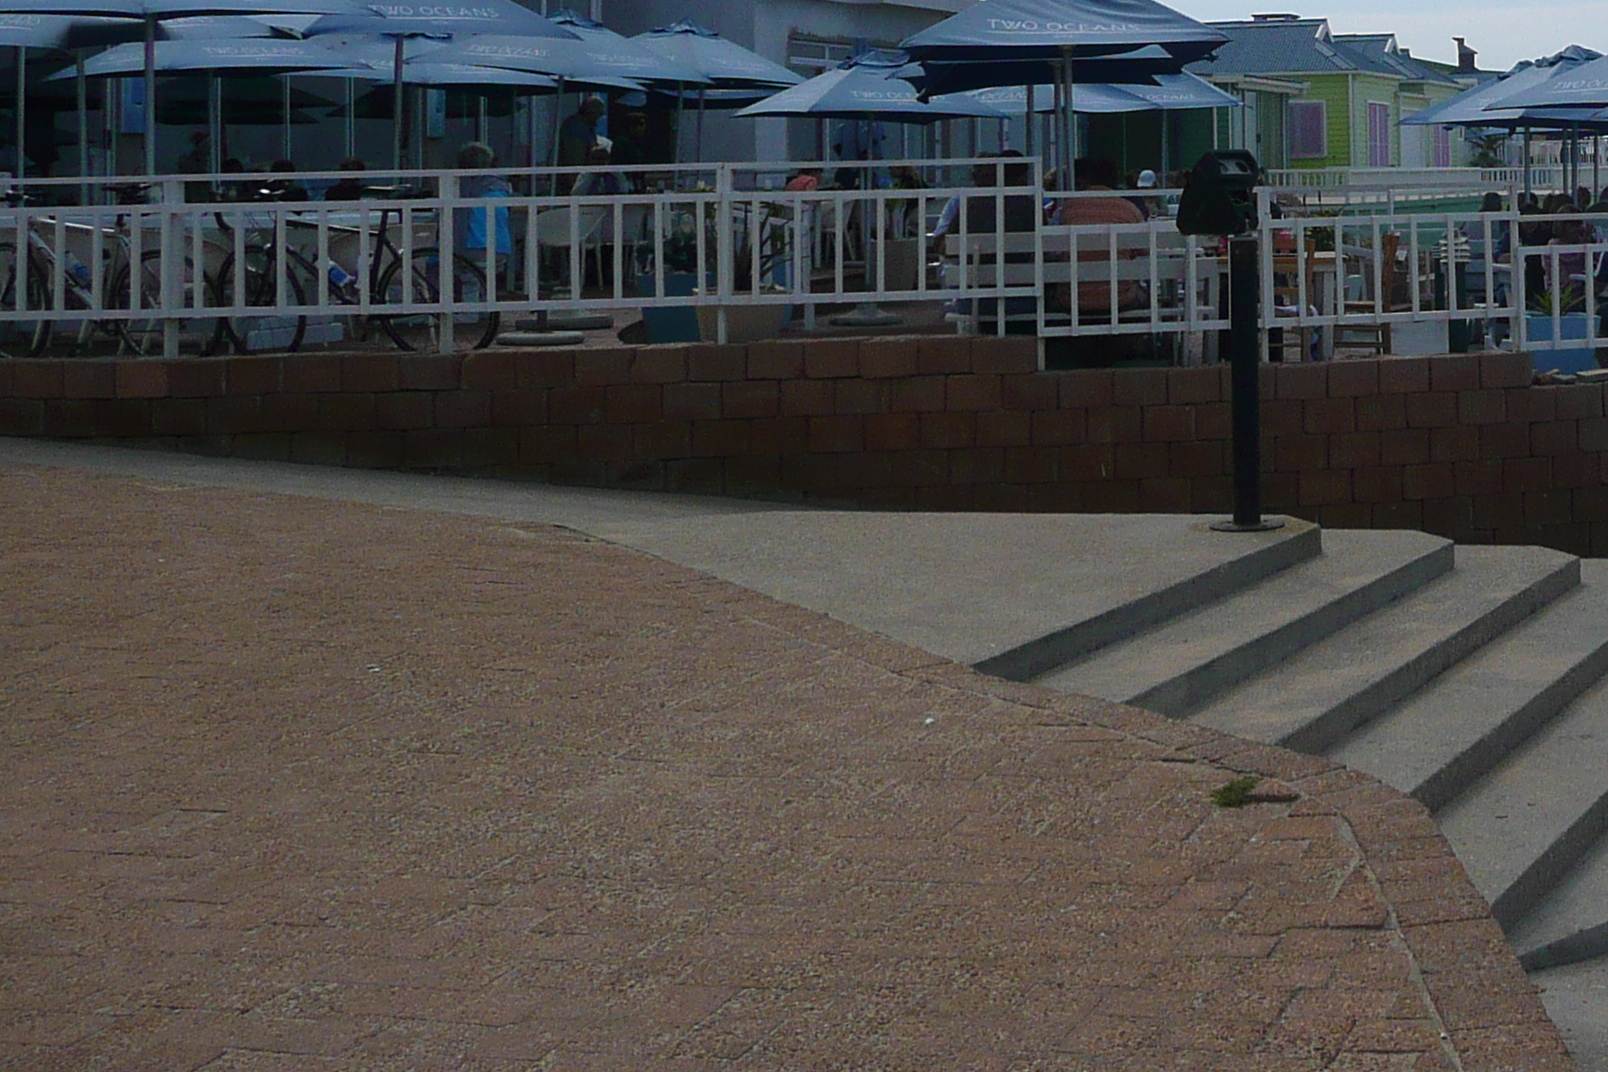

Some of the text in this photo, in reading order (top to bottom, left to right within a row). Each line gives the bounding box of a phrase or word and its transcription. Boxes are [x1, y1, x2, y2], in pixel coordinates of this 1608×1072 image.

[368, 5, 499, 18] TWO OCEANS
[988, 18, 1140, 32] TWO OCEANS
[1553, 80, 1586, 90] TWO
